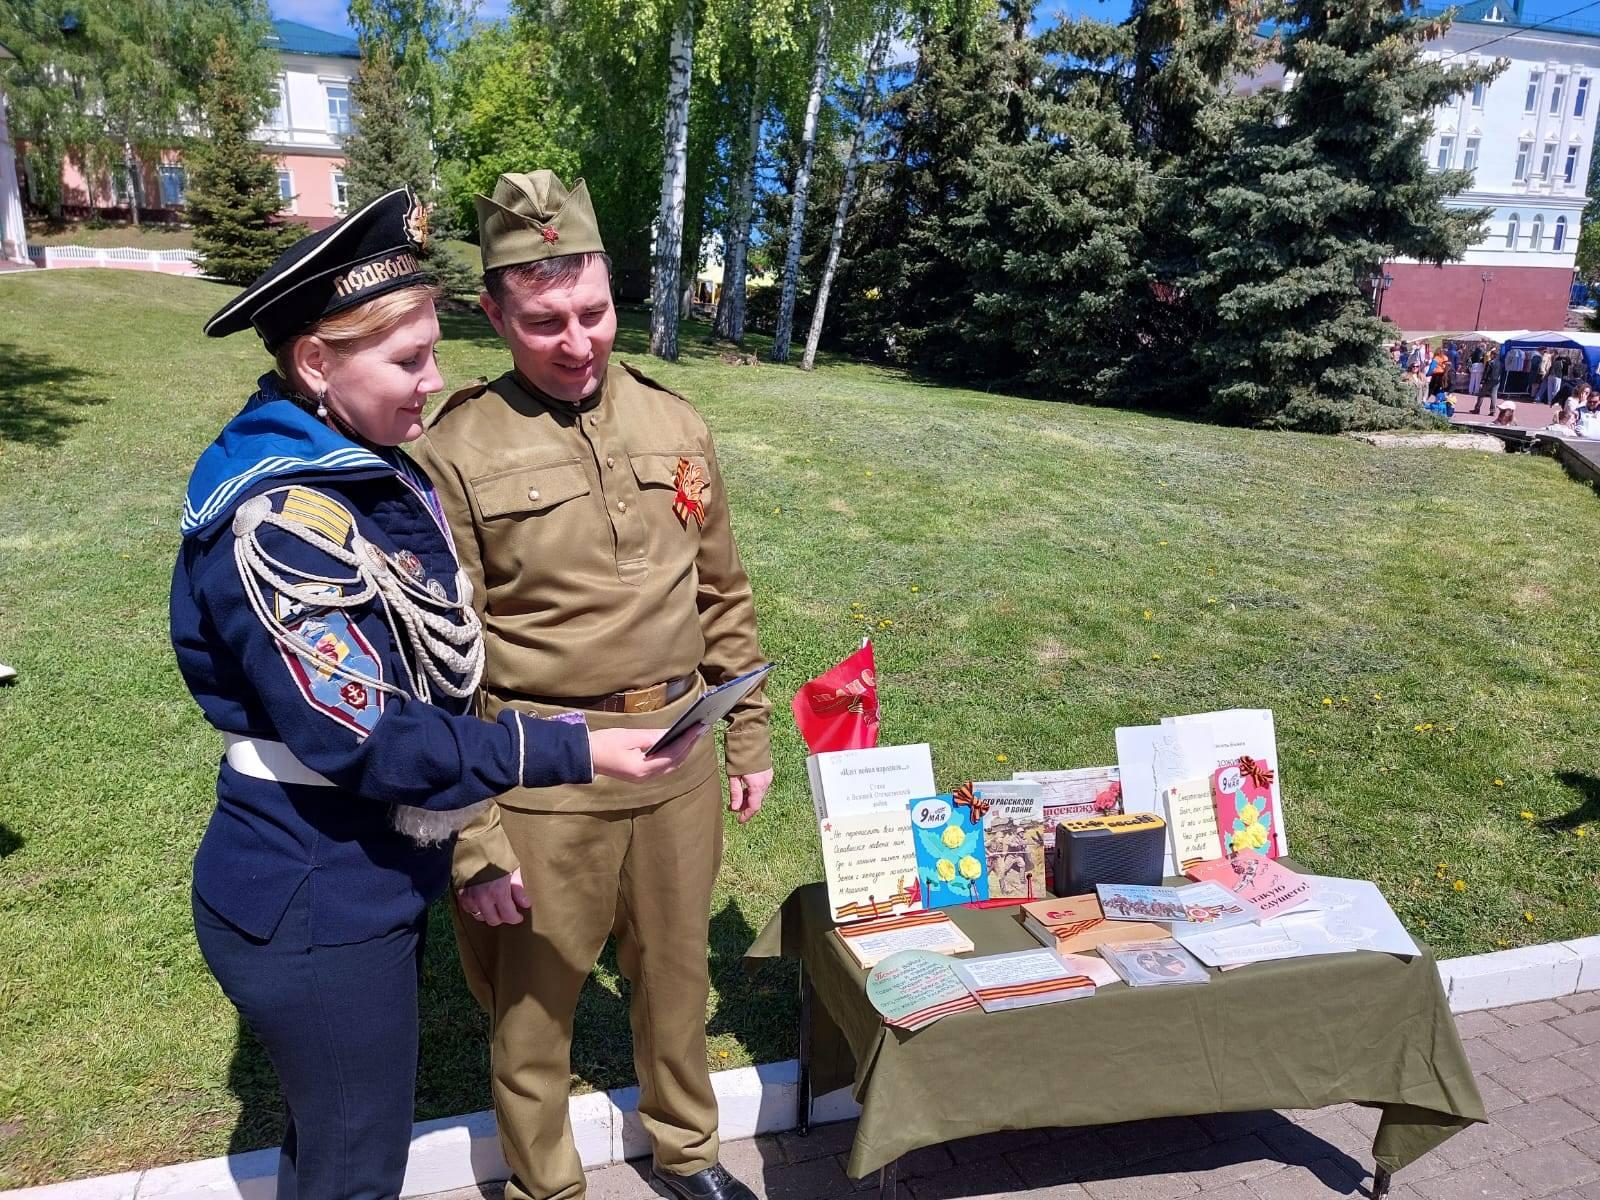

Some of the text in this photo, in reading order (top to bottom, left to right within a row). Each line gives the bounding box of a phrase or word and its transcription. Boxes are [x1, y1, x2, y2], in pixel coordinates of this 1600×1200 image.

[1222, 777, 1229, 791] 9
[996, 798, 1035, 807] РАССКАЗОВ
[918, 807, 929, 823] 9
[928, 813, 946, 822] МАЯ
[1260, 881, 1310, 911] едущего!
